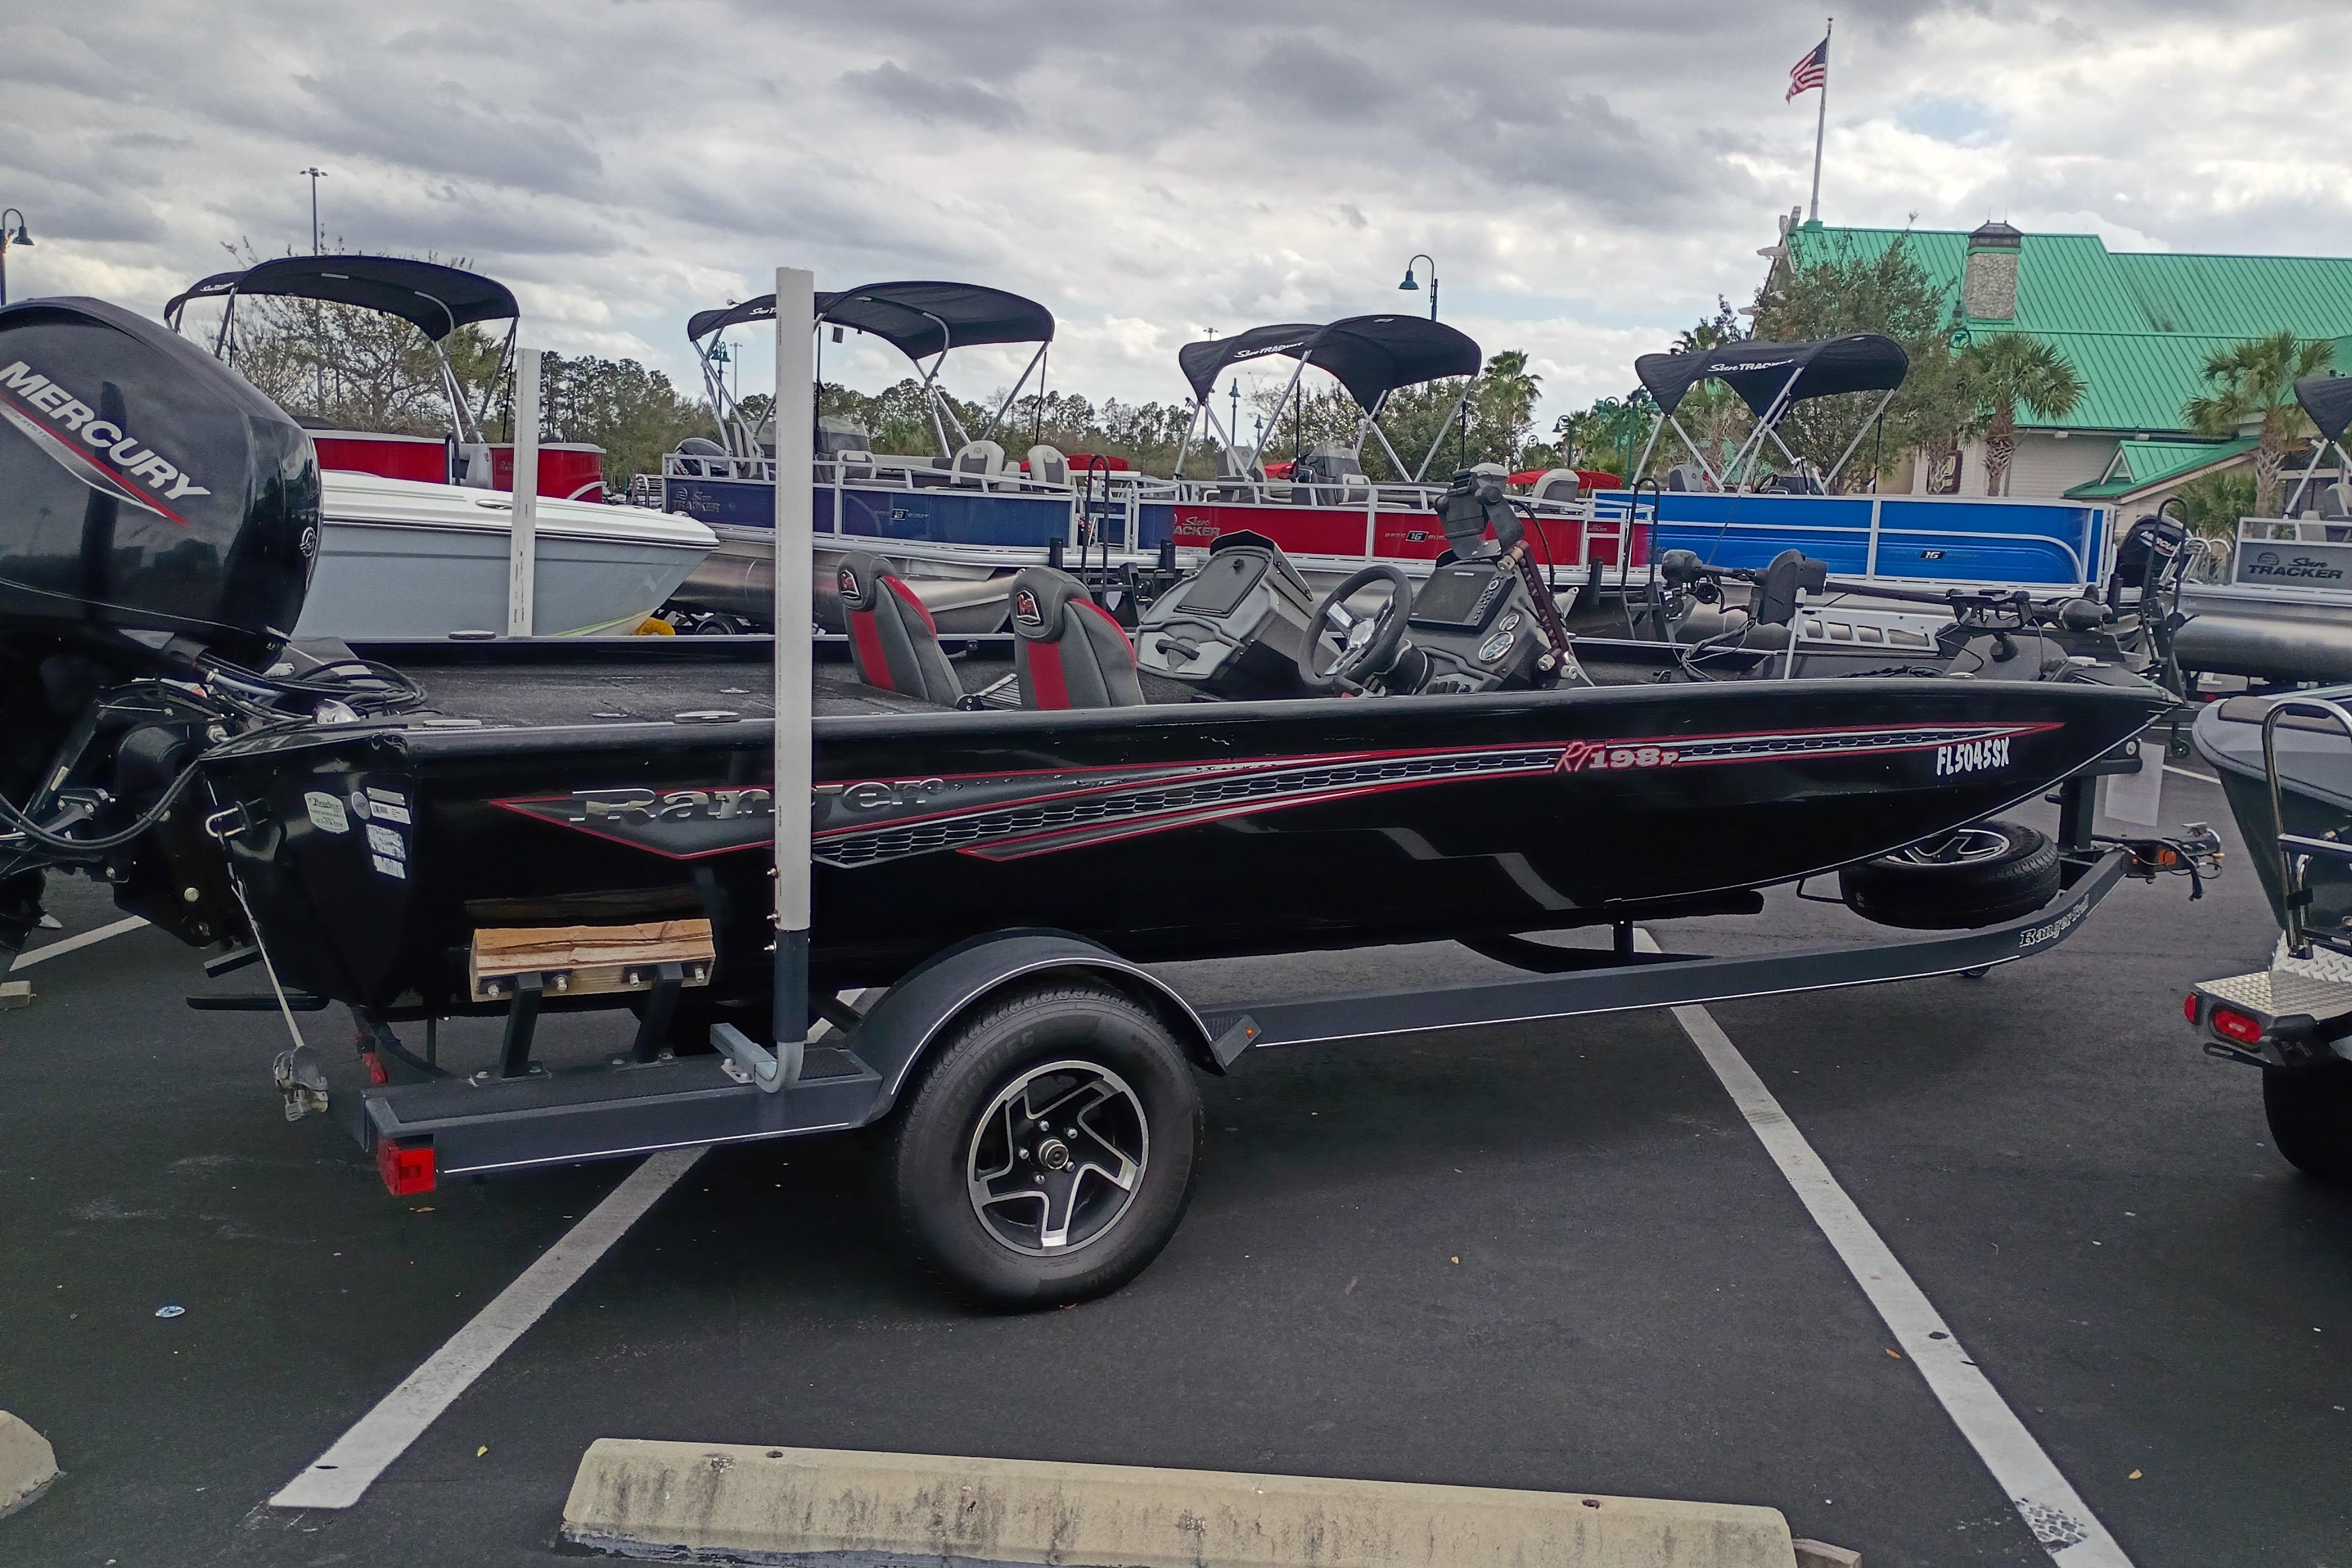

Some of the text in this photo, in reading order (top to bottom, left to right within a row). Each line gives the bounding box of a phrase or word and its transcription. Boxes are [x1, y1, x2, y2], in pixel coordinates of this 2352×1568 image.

[1259, 342, 1304, 354] TRAC
[1707, 359, 1794, 372] Sun TRAC
[0, 361, 211, 500] MERCURY
[2288, 557, 2328, 568] Sun
[2249, 564, 2343, 579] TRACKER
[569, 779, 946, 821] Raner
